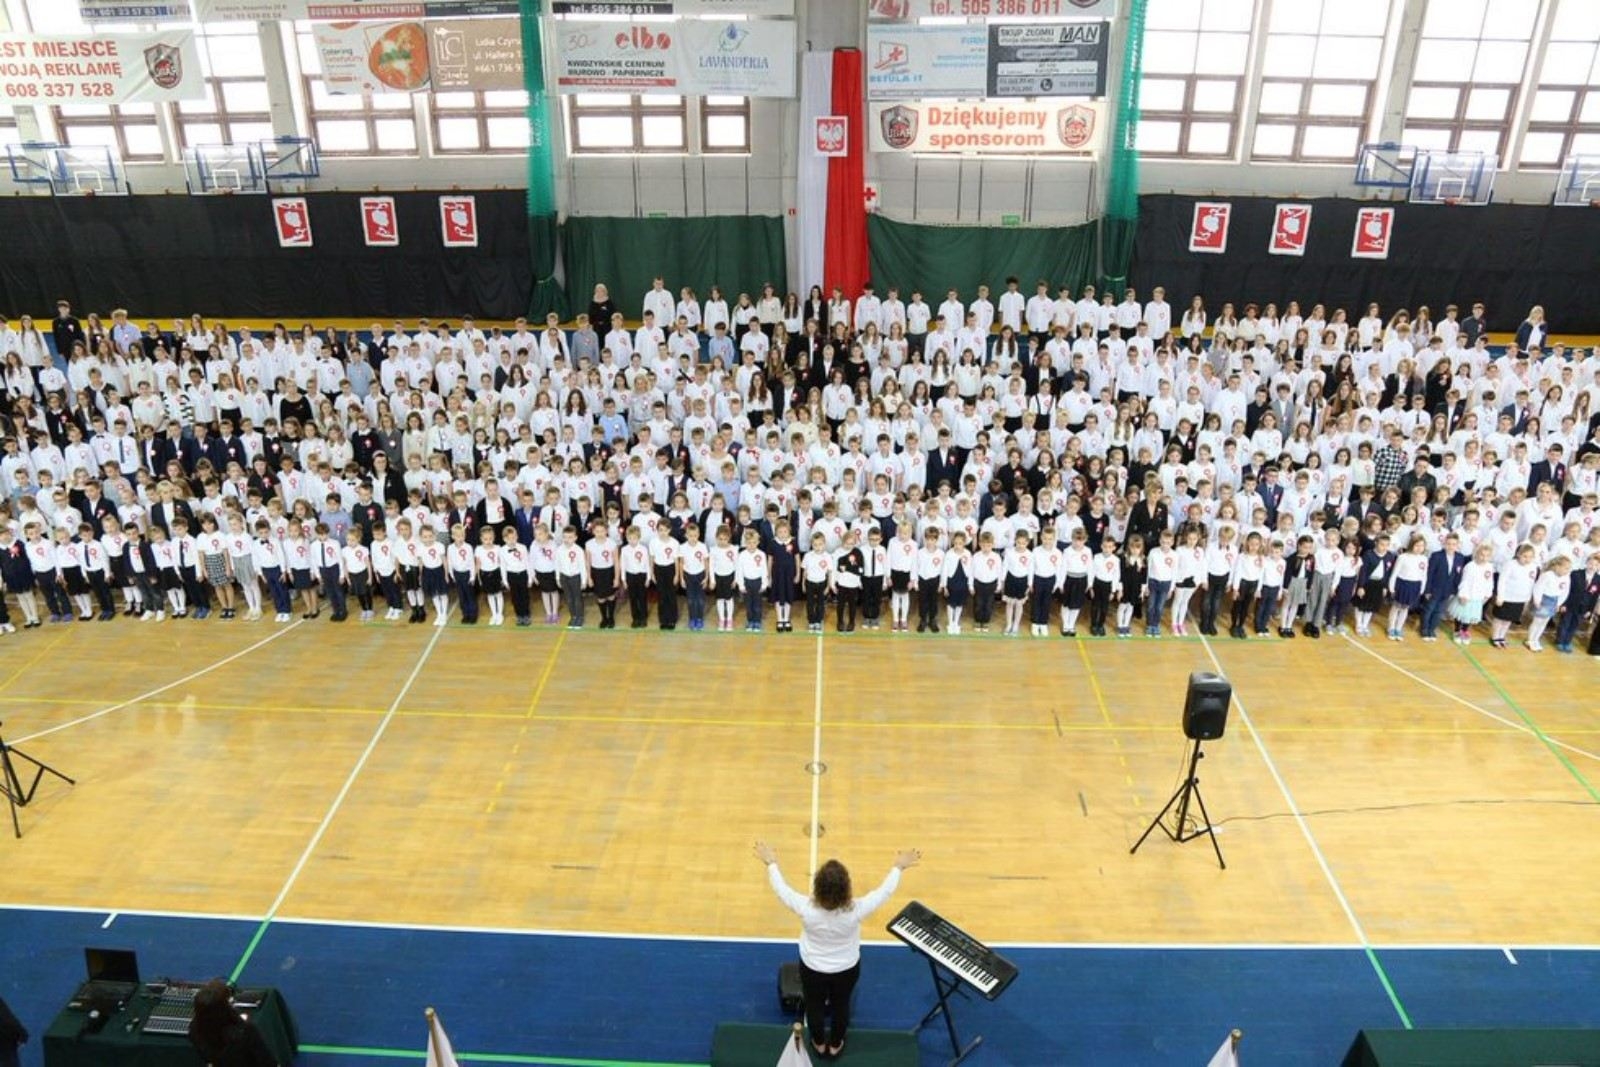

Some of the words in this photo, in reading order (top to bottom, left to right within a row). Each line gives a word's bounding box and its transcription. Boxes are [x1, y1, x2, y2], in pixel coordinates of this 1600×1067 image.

[569, 4, 588, 14] tel.
[591, 4, 610, 14] 505
[636, 4, 655, 14] 011
[930, 0, 955, 15] tel.
[961, 0, 991, 15] 505
[996, 0, 1026, 15] 386
[1031, 0, 1060, 15] 011
[615, 26, 672, 50] elbo
[1059, 26, 1099, 43] MAN
[32, 41, 118, 57] MIEJSCE
[625, 60, 666, 69] CENTRUM
[698, 56, 769, 69] LAVANDERIA
[44, 62, 122, 79] REKLAMĘ
[567, 69, 607, 77] BIUROWO
[5, 83, 39, 97] 608
[43, 83, 75, 97] 337
[81, 82, 114, 97] 528
[928, 107, 1048, 130] Dziękujemy
[929, 132, 1045, 149] sponsorom
